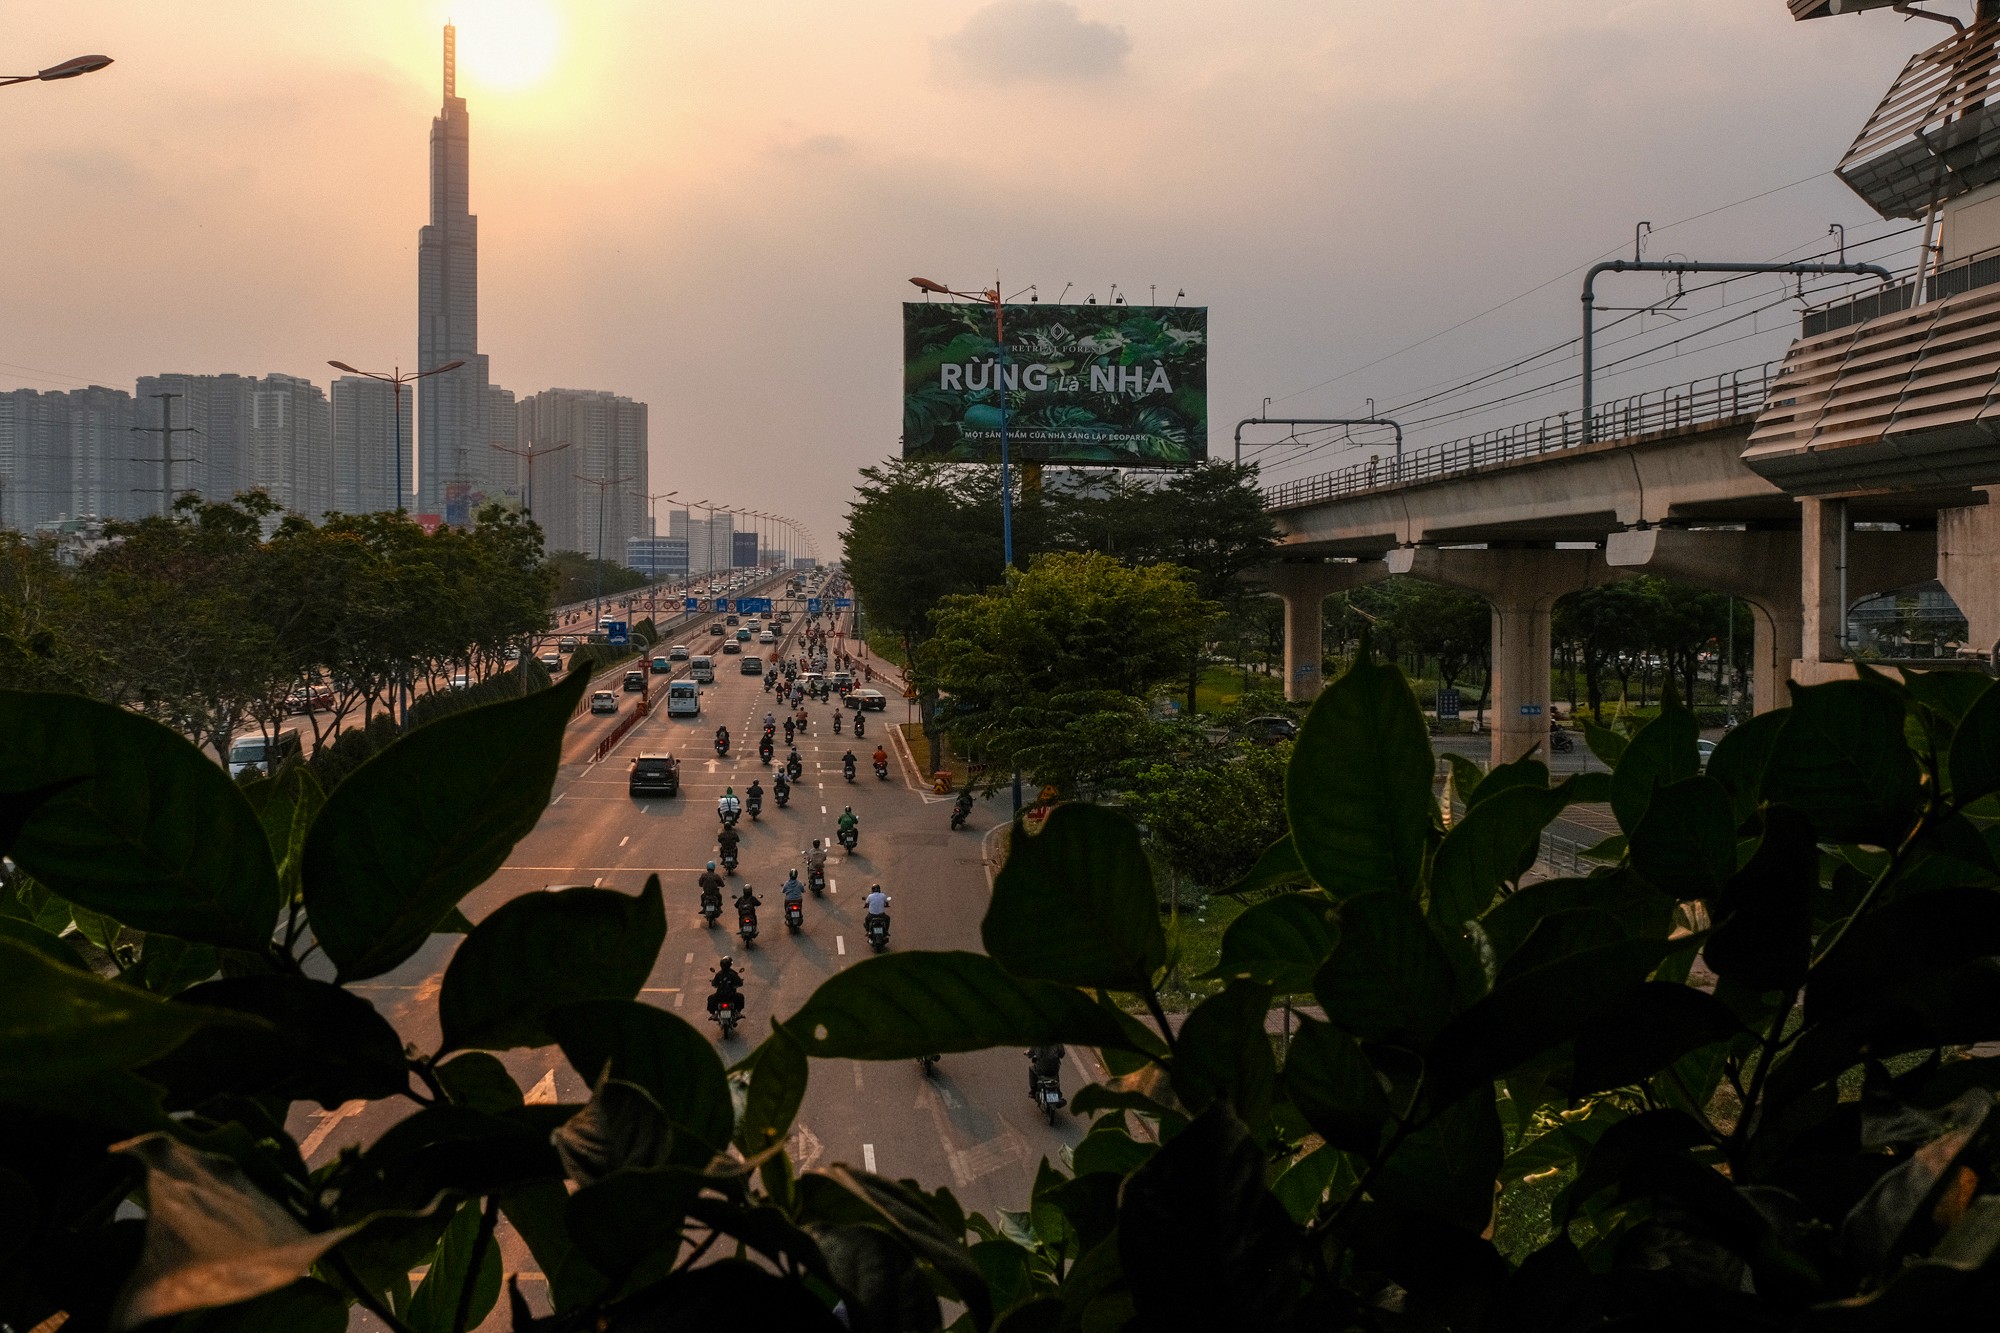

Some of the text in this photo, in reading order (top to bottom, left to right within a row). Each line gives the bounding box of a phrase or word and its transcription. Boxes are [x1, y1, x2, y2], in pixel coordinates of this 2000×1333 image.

[940, 356, 1173, 393] RỪNG Là NHÀ
[965, 430, 984, 440] MỘT
[1029, 430, 1046, 439] CỦA
[1048, 431, 1066, 439] NHÀ
[1068, 431, 1090, 440] SÁNG
[1109, 433, 1147, 441] ECOPARK
